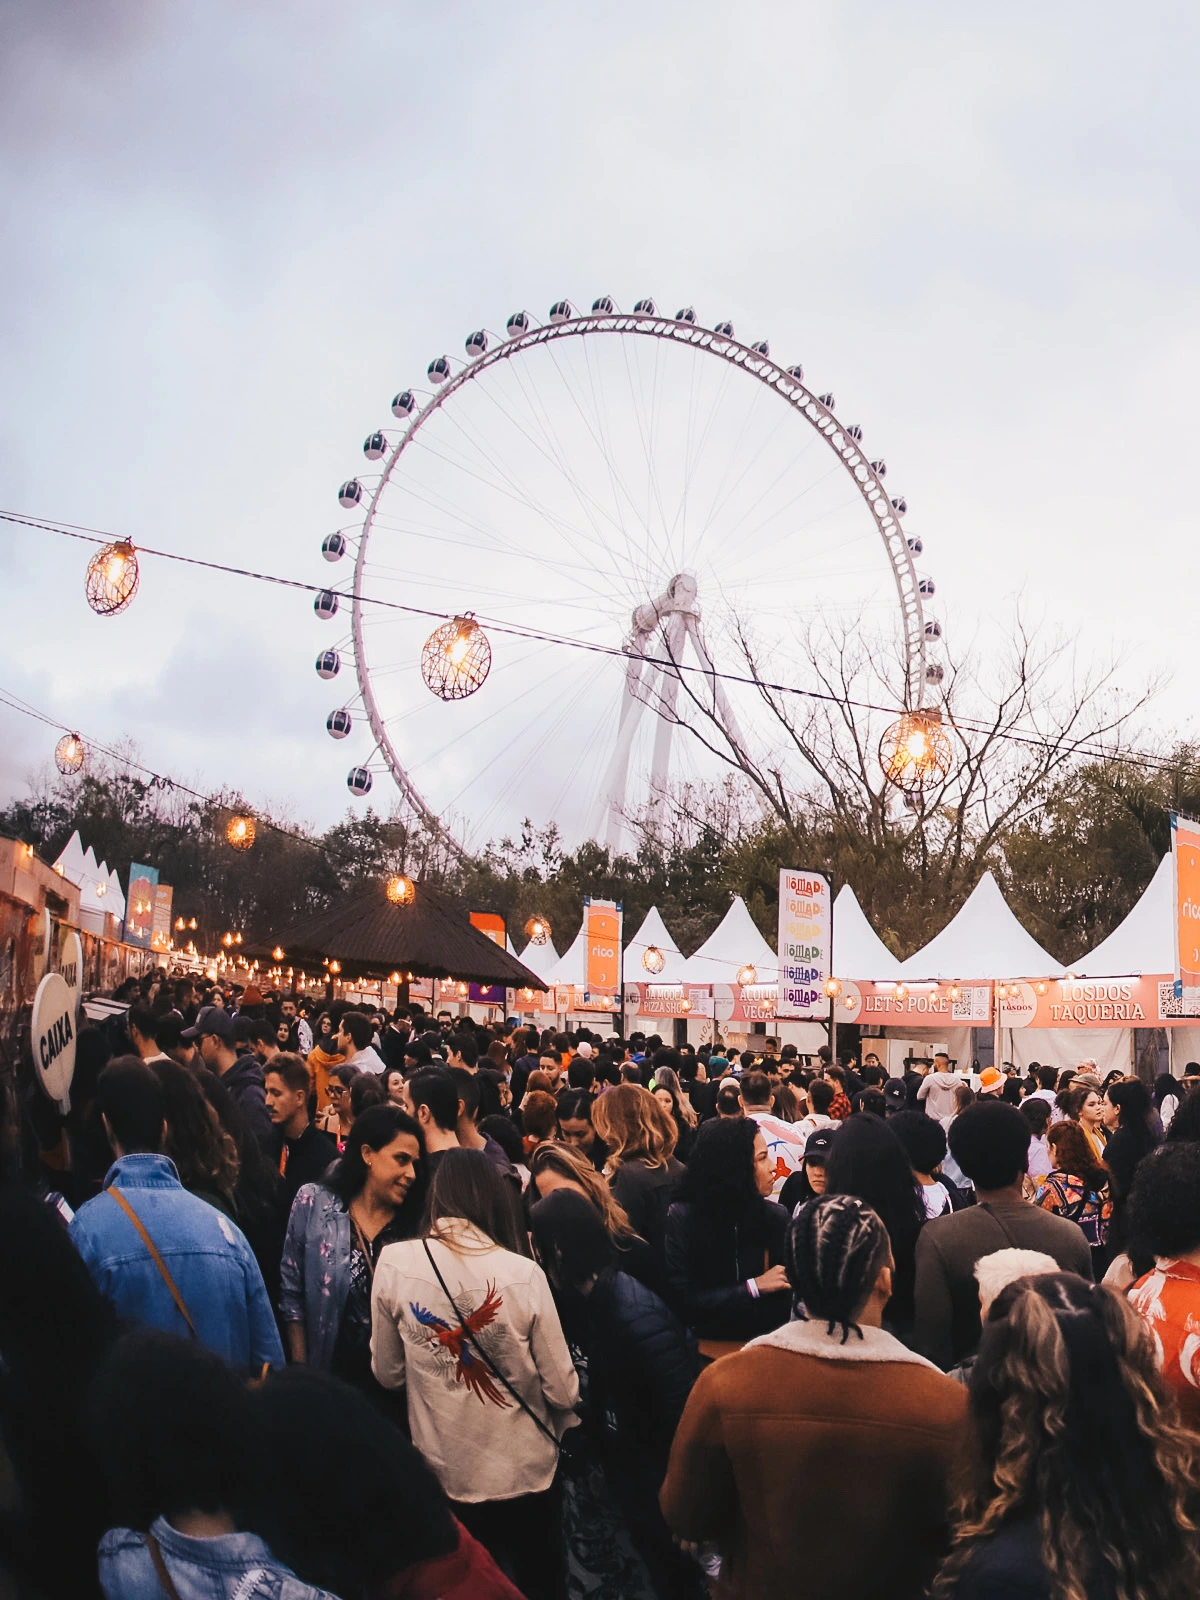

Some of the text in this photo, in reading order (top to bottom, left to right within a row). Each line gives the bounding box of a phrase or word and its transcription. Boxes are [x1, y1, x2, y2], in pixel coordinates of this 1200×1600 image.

[592, 945, 614, 958] rico
[645, 988, 656, 1000] DA
[1061, 984, 1132, 1002] LOSDOS
[643, 1001, 684, 1014] PIZZA SHO
[865, 995, 904, 1013] LET'S
[1050, 1003, 1145, 1024] TAQUERIA
[39, 1010, 73, 1071] CAIXA
